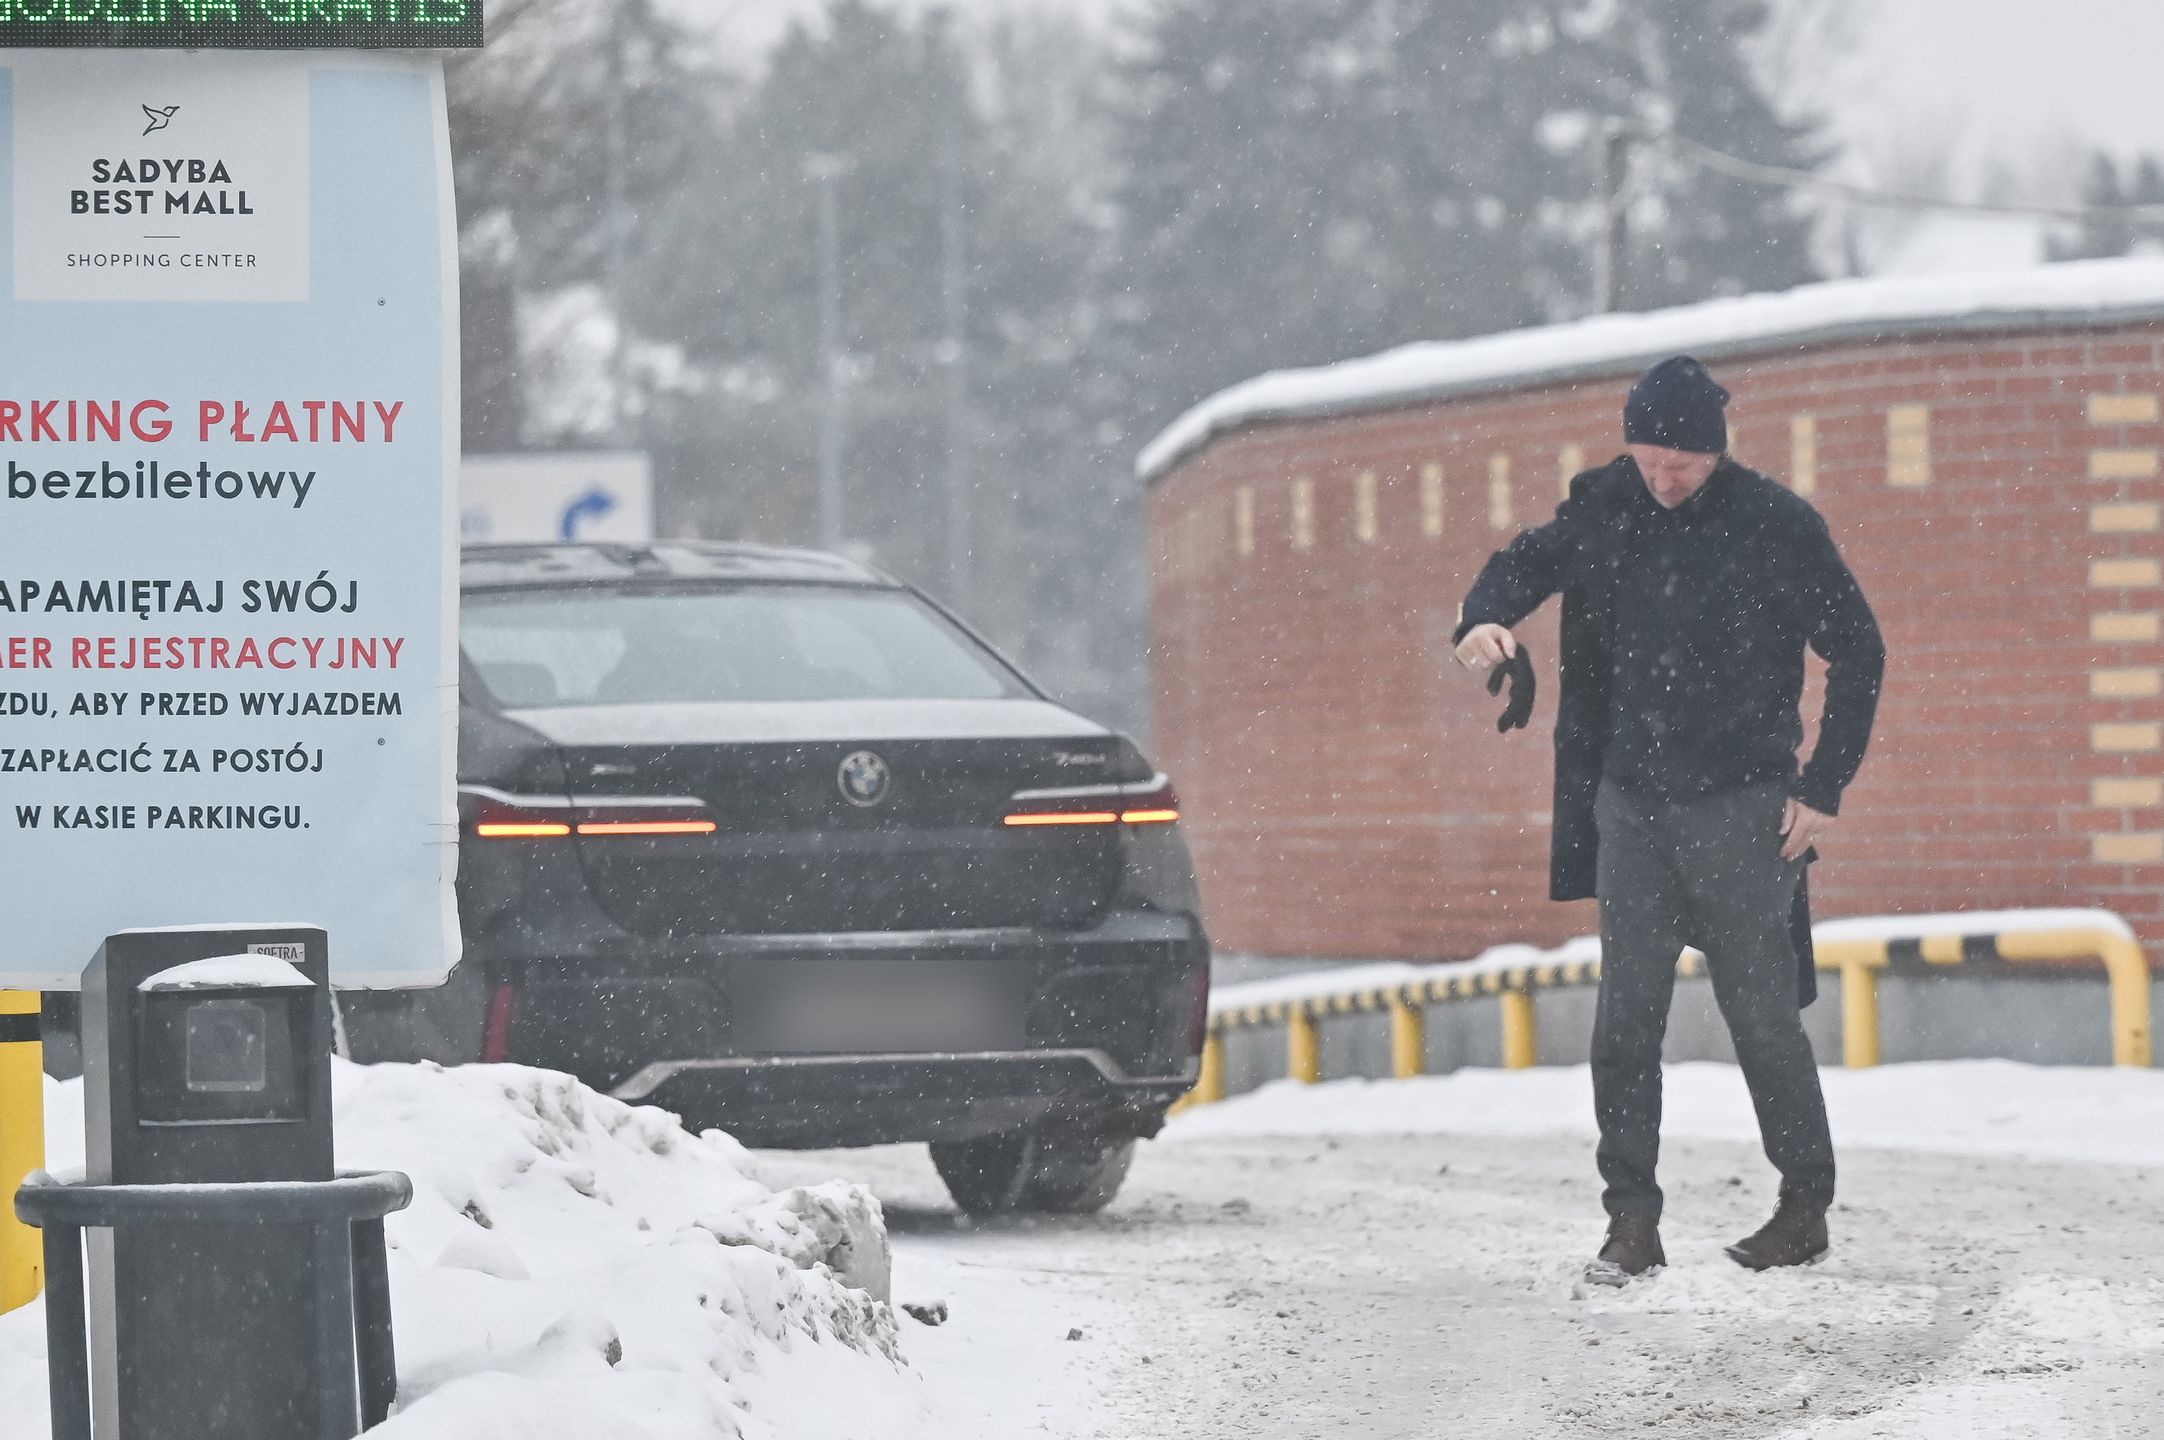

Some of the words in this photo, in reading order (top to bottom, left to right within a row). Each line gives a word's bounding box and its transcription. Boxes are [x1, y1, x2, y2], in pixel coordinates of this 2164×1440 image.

[92, 159, 232, 183] SADYBA
[71, 190, 153, 214] BEST
[165, 190, 253, 214] MALL
[67, 254, 170, 267] SHOPPING
[180, 254, 256, 267] CENTER
[200, 400, 403, 442] PŁATNY
[8, 460, 316, 508] bezbiletowy
[242, 570, 357, 613] SWÓJ
[0, 637, 52, 669] ER
[72, 637, 404, 669] REJESTRACYJNY
[69, 693, 128, 715] ABY
[141, 693, 228, 715] PRZED
[240, 693, 402, 715] WYJAZDEM
[1, 742, 152, 772] ZAPŁACIĆ
[163, 749, 200, 772] ZA
[213, 742, 323, 772] POSTÓJ
[16, 806, 41, 828] W
[54, 806, 135, 829] KASIE
[148, 805, 310, 829] PARKINGU.
